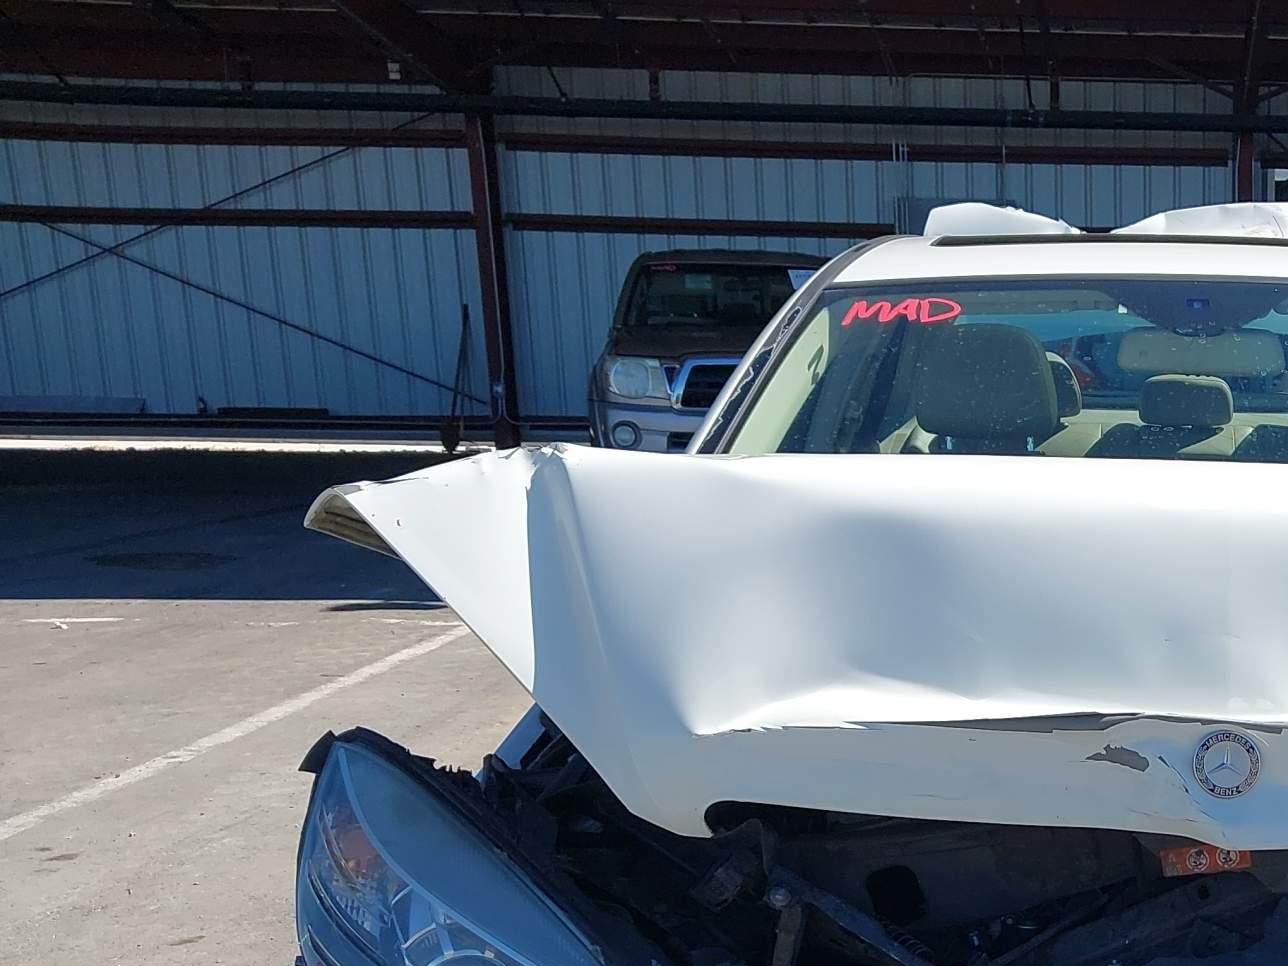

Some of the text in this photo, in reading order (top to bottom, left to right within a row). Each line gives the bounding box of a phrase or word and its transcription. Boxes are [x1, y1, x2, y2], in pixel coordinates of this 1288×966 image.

[841, 297, 962, 326] MAD
[1206, 733, 1250, 749] MERCEDES
[1214, 787, 1238, 796] BENZ
